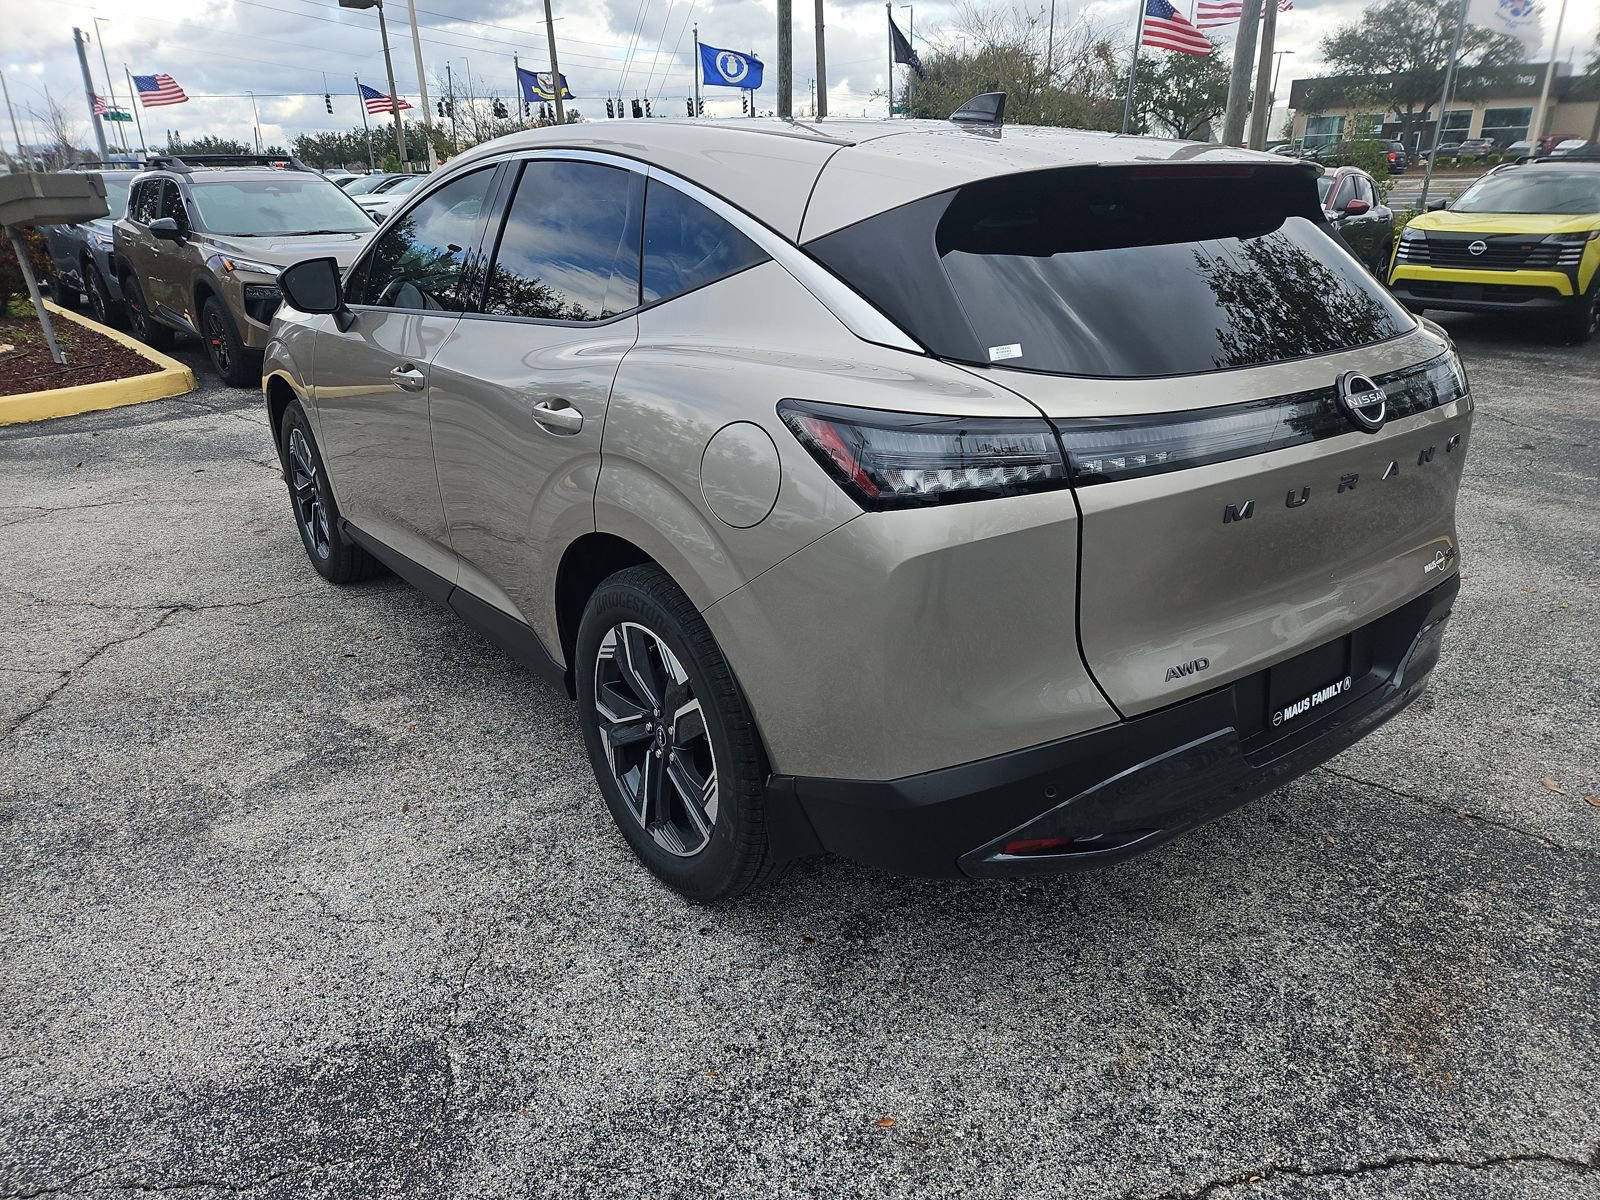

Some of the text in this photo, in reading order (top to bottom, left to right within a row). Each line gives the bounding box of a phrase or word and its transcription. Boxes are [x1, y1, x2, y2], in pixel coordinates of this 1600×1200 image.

[1347, 390, 1387, 408] NISSAN
[1223, 433, 1461, 524] MURANO
[595, 591, 673, 637] BRIDGESTONE
[1165, 657, 1210, 682] AWD
[1283, 680, 1343, 721] MAUS FAMILY
